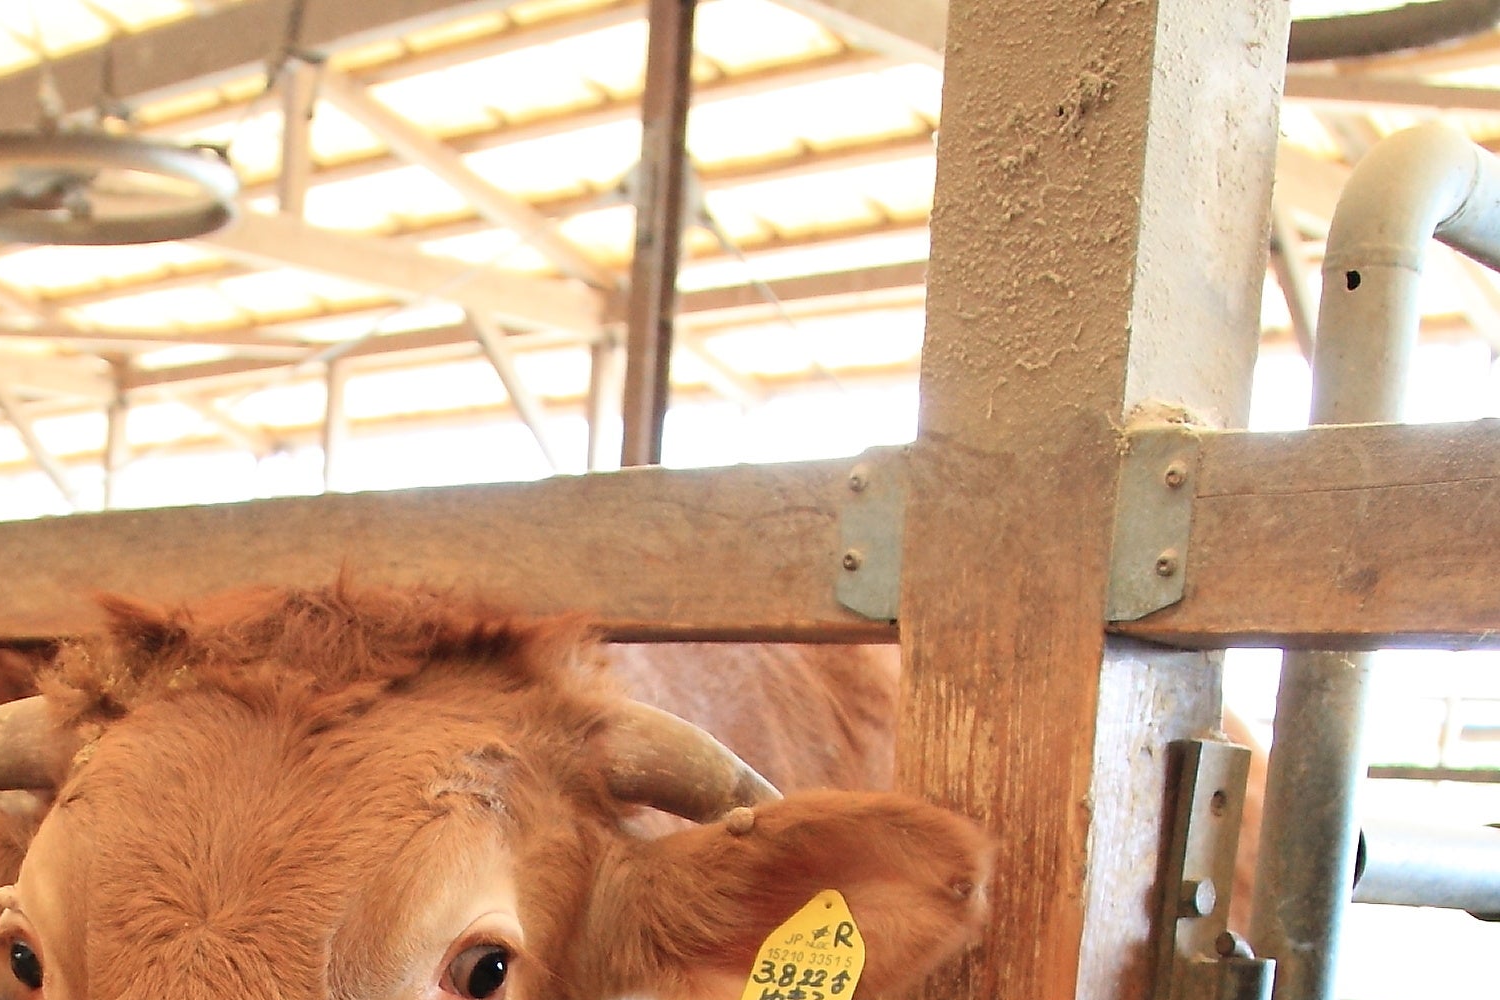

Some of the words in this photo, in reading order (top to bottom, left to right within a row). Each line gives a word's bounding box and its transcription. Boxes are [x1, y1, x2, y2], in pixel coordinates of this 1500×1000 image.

[785, 933, 804, 945] JP
[834, 921, 853, 948] R
[767, 948, 804, 962] 15210
